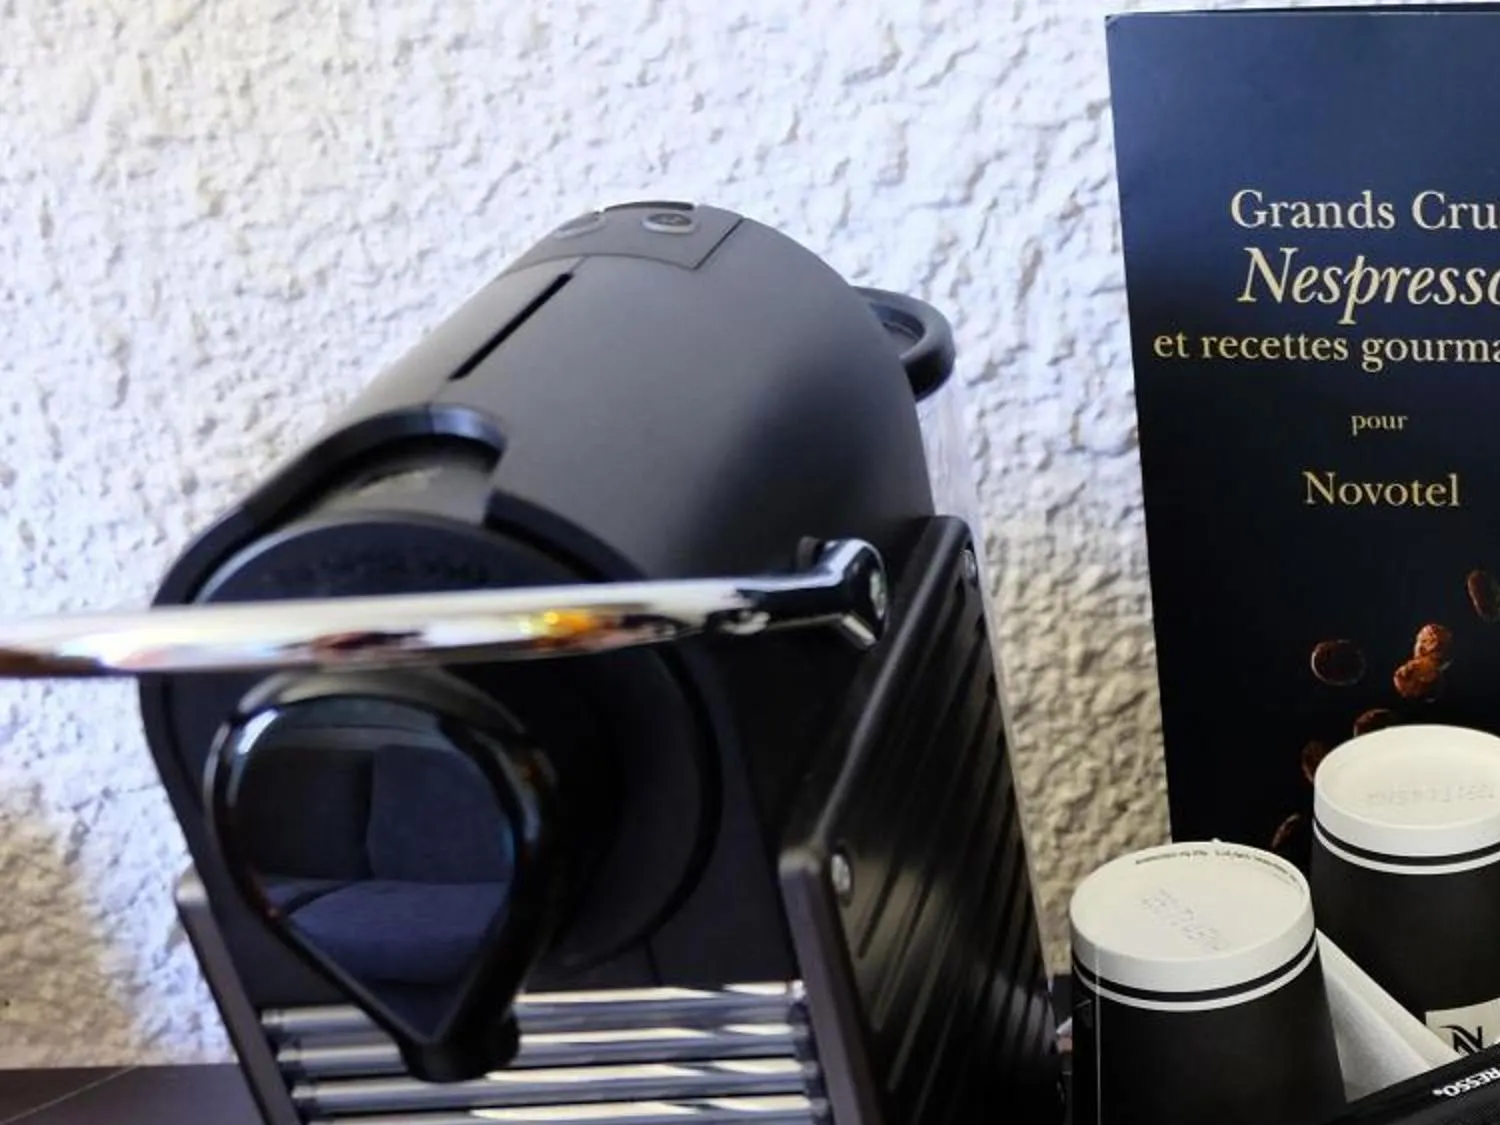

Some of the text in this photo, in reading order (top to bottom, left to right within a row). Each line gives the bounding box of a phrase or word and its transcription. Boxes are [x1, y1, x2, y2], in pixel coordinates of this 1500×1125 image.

[1230, 189, 1396, 231] Grands
[1153, 332, 1188, 360] et
[1201, 330, 1349, 362] recettes
[1351, 412, 1408, 437] pour
[1303, 472, 1460, 508] Novotel
